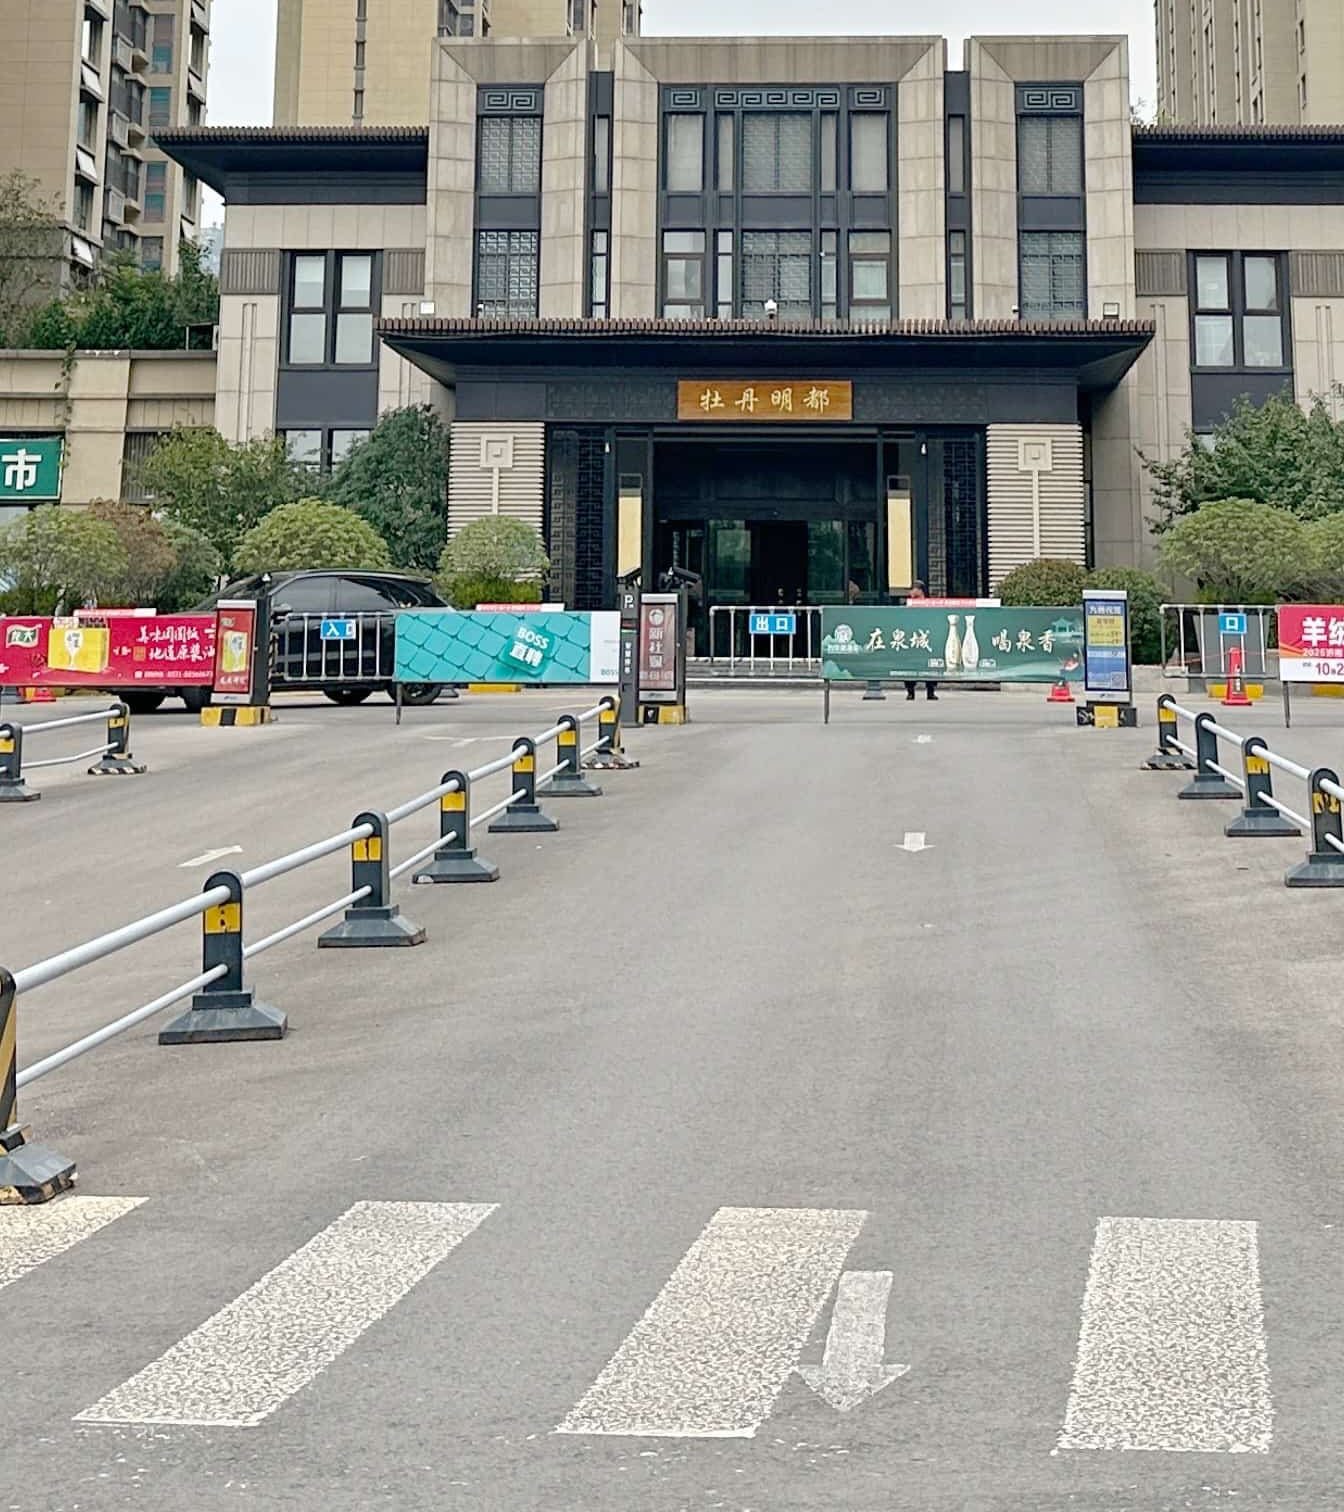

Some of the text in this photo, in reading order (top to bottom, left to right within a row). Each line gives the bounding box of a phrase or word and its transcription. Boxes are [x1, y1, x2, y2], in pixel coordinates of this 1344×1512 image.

[700, 387, 829, 413] 牡丹明都
[756, 616, 789, 632] 出口
[516, 626, 550, 649] BOSS
[864, 627, 933, 653] 在泉城
[509, 642, 544, 667] 直聘
